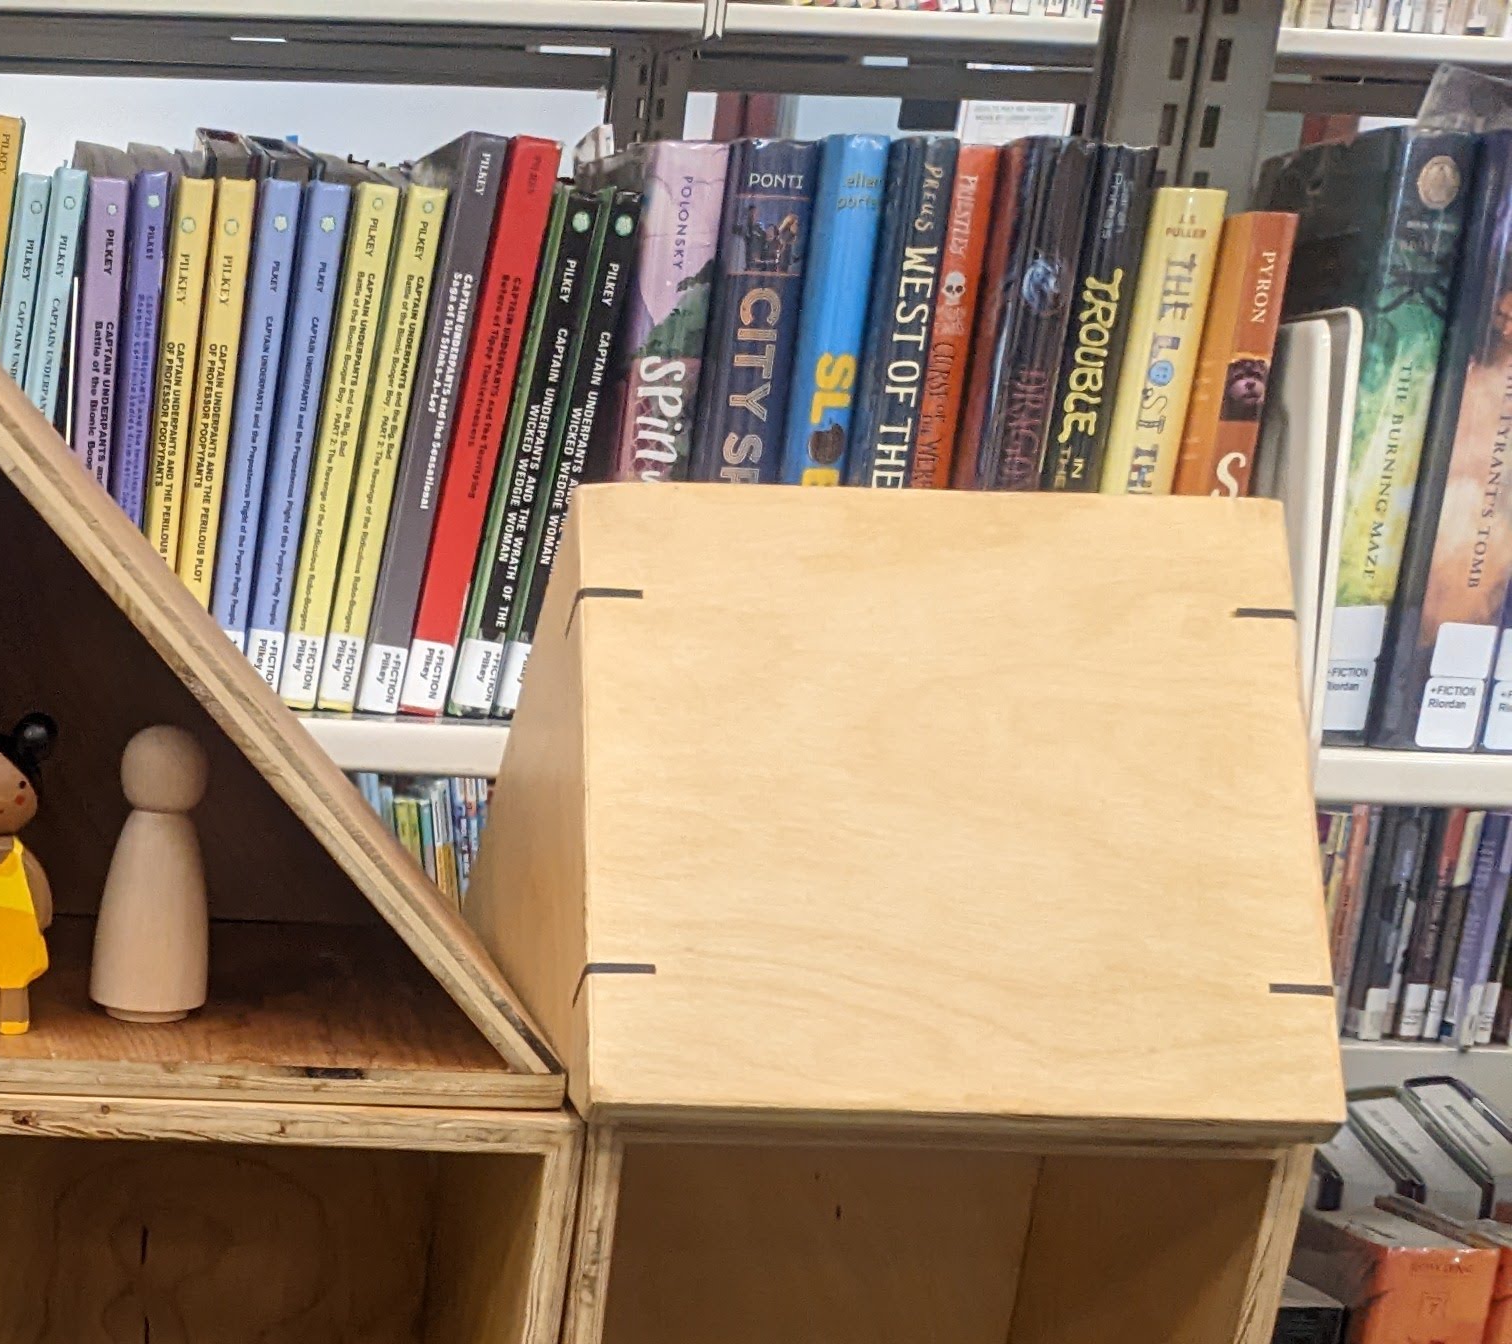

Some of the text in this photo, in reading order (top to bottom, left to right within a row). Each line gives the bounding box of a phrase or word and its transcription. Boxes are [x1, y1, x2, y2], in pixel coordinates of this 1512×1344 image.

[475, 152, 491, 196] PILKEY
[748, 172, 804, 190] PONTI
[103, 229, 115, 276] PILKEY
[365, 217, 379, 258] PILKEY
[414, 220, 429, 261] PILKEY
[672, 175, 694, 271] POLONSKY
[21, 238, 35, 281] PILKEY
[55, 234, 68, 278] PILKEY
[219, 255, 233, 306] PILKEY
[270, 260, 281, 293] PILKEY
[317, 261, 327, 293] PILKEY
[559, 259, 578, 304] PILKEY
[601, 262, 620, 307] PILKEY
[1158, 253, 1197, 321] THE
[1250, 250, 1277, 324] PYRON
[13, 300, 28, 352] CAPTAIN
[350, 272, 376, 387] CAPTAIN UNDERPANTS
[397, 275, 425, 390] CAPTAIN UNDERPANTS
[428, 272, 463, 413] Saga of Sir Stinks-A-Lot
[729, 287, 781, 423] CITY
[1057, 267, 1123, 443] TROUBLE
[97, 321, 114, 462] CAPTAIN UNDERPANTS
[420, 273, 473, 510] CAPTAIN UNDERPANTS and the Sensational
[871, 245, 939, 488] WEST OF THE
[155, 341, 175, 487] OF PROFESSOR POOPYPANTS
[194, 343, 218, 489] OF PROFESSOR POOPYPANTS
[571, 331, 611, 474] CAPTAIN UNDERPANTS
[160, 342, 186, 554] CAPTAIN UNDERPANTS AND THE PERILOUS
[193, 344, 228, 584] CAPTAIN UNDERPANTS AND THE PERILOUS PLOT
[495, 327, 569, 629] CAPTAIN UNDERPANTS AND THE WRATH OF THE
[1070, 458, 1085, 479] IN
[1363, 362, 1412, 580] THE BURNING MAZE
[498, 403, 541, 563] WICKED WEDGIE WOMAN
[539, 407, 583, 566] WICKED WEDGIE WOMAN
[1468, 525, 1491, 588] TOMB
[293, 638, 307, 672] Pilkey
[332, 639, 347, 672] Pilkey
[376, 652, 391, 684] Pilkey
[419, 647, 436, 680] Pilkey
[476, 650, 491, 683] Pilkey
[1428, 699, 1466, 709] Riordan
